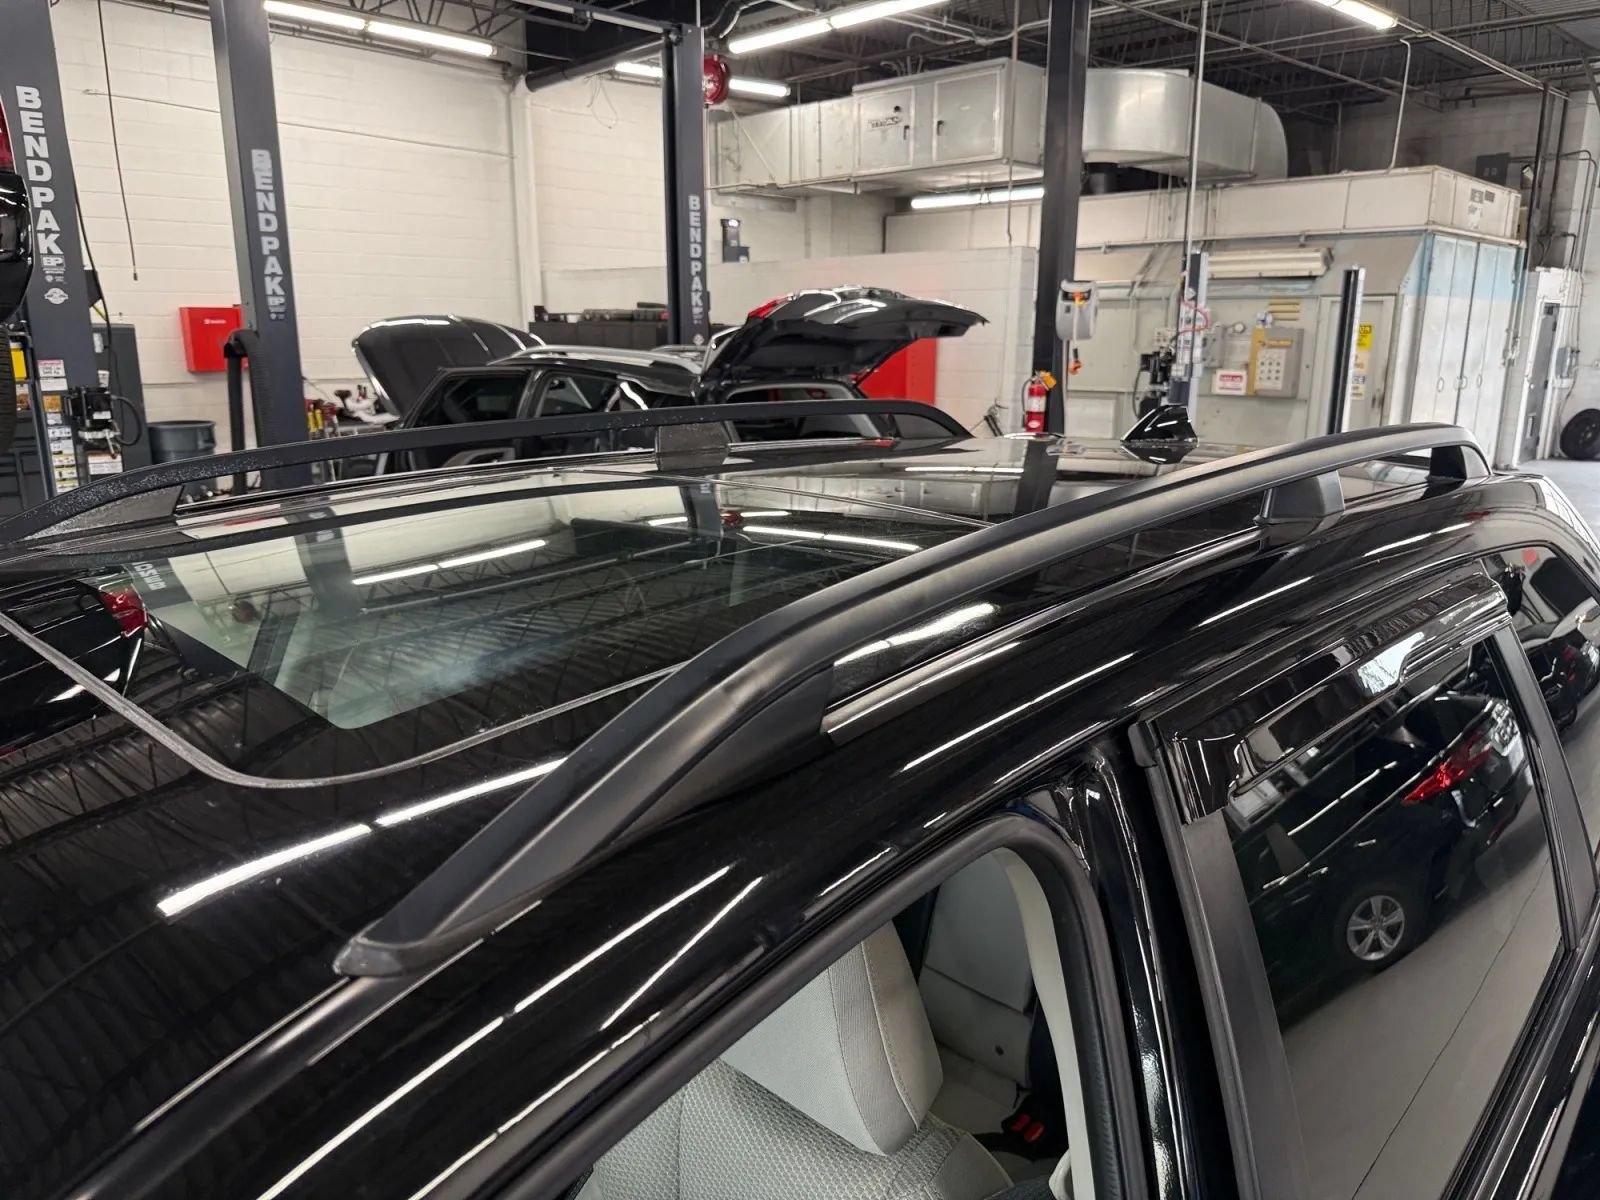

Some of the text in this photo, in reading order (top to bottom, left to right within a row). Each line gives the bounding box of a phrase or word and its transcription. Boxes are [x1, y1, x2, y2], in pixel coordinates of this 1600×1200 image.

[15, 85, 64, 255] BENDPAK
[251, 149, 286, 295] BENDPAK
[688, 194, 703, 306] BENDPAK
